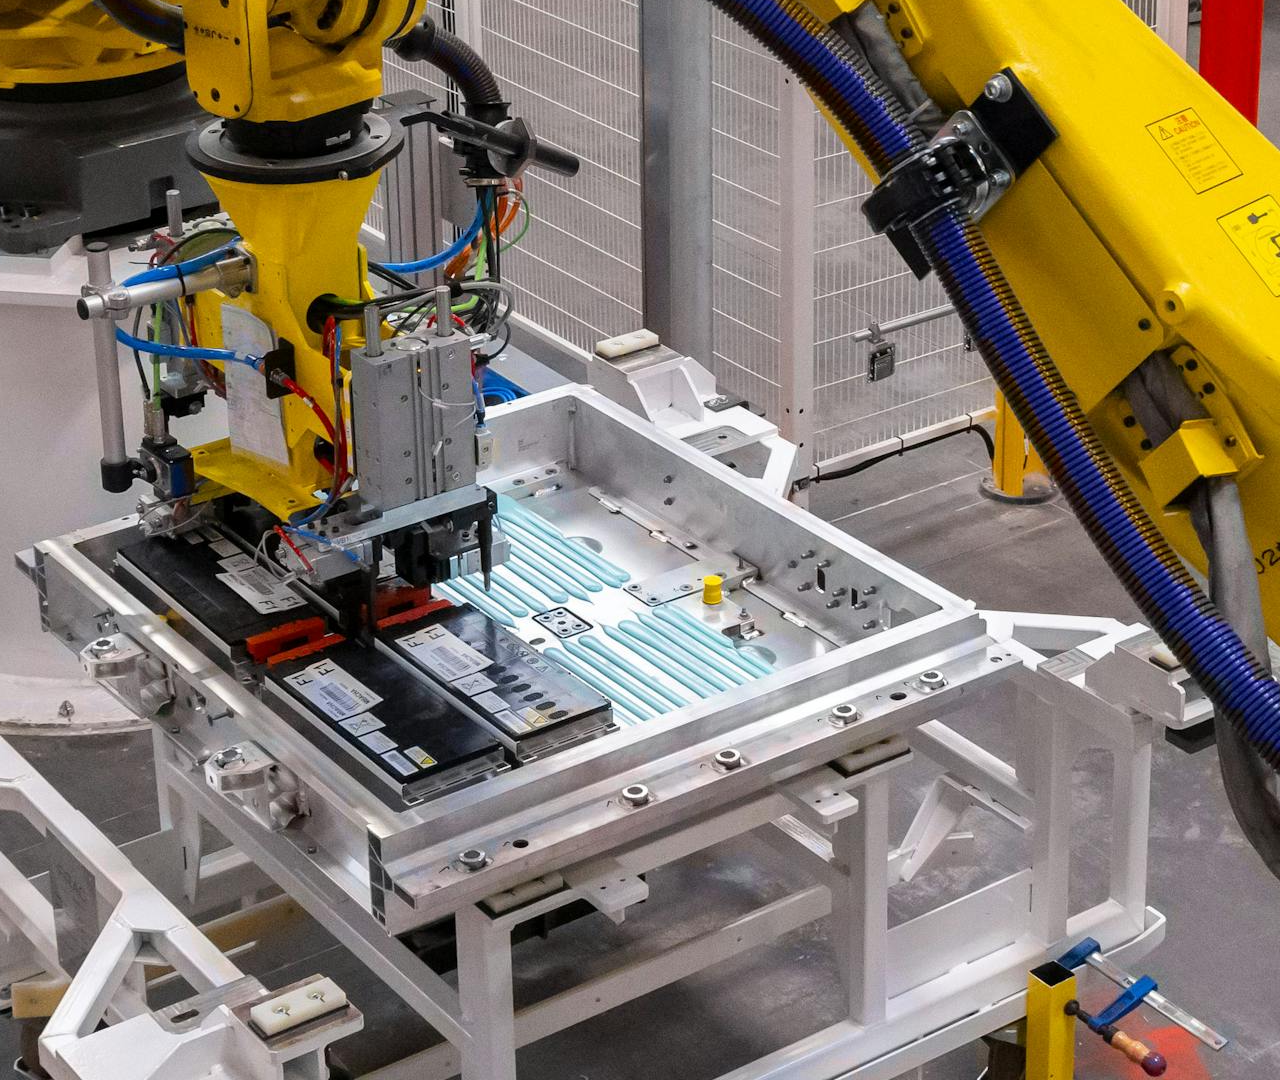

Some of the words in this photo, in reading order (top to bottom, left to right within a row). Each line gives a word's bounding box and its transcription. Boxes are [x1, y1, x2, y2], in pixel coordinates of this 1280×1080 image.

[258, 600, 276, 611] F1
[279, 595, 300, 608] F1
[424, 627, 447, 640] F1
[402, 636, 424, 648] F1
[313, 662, 335, 676] F1
[291, 673, 314, 686] F1
